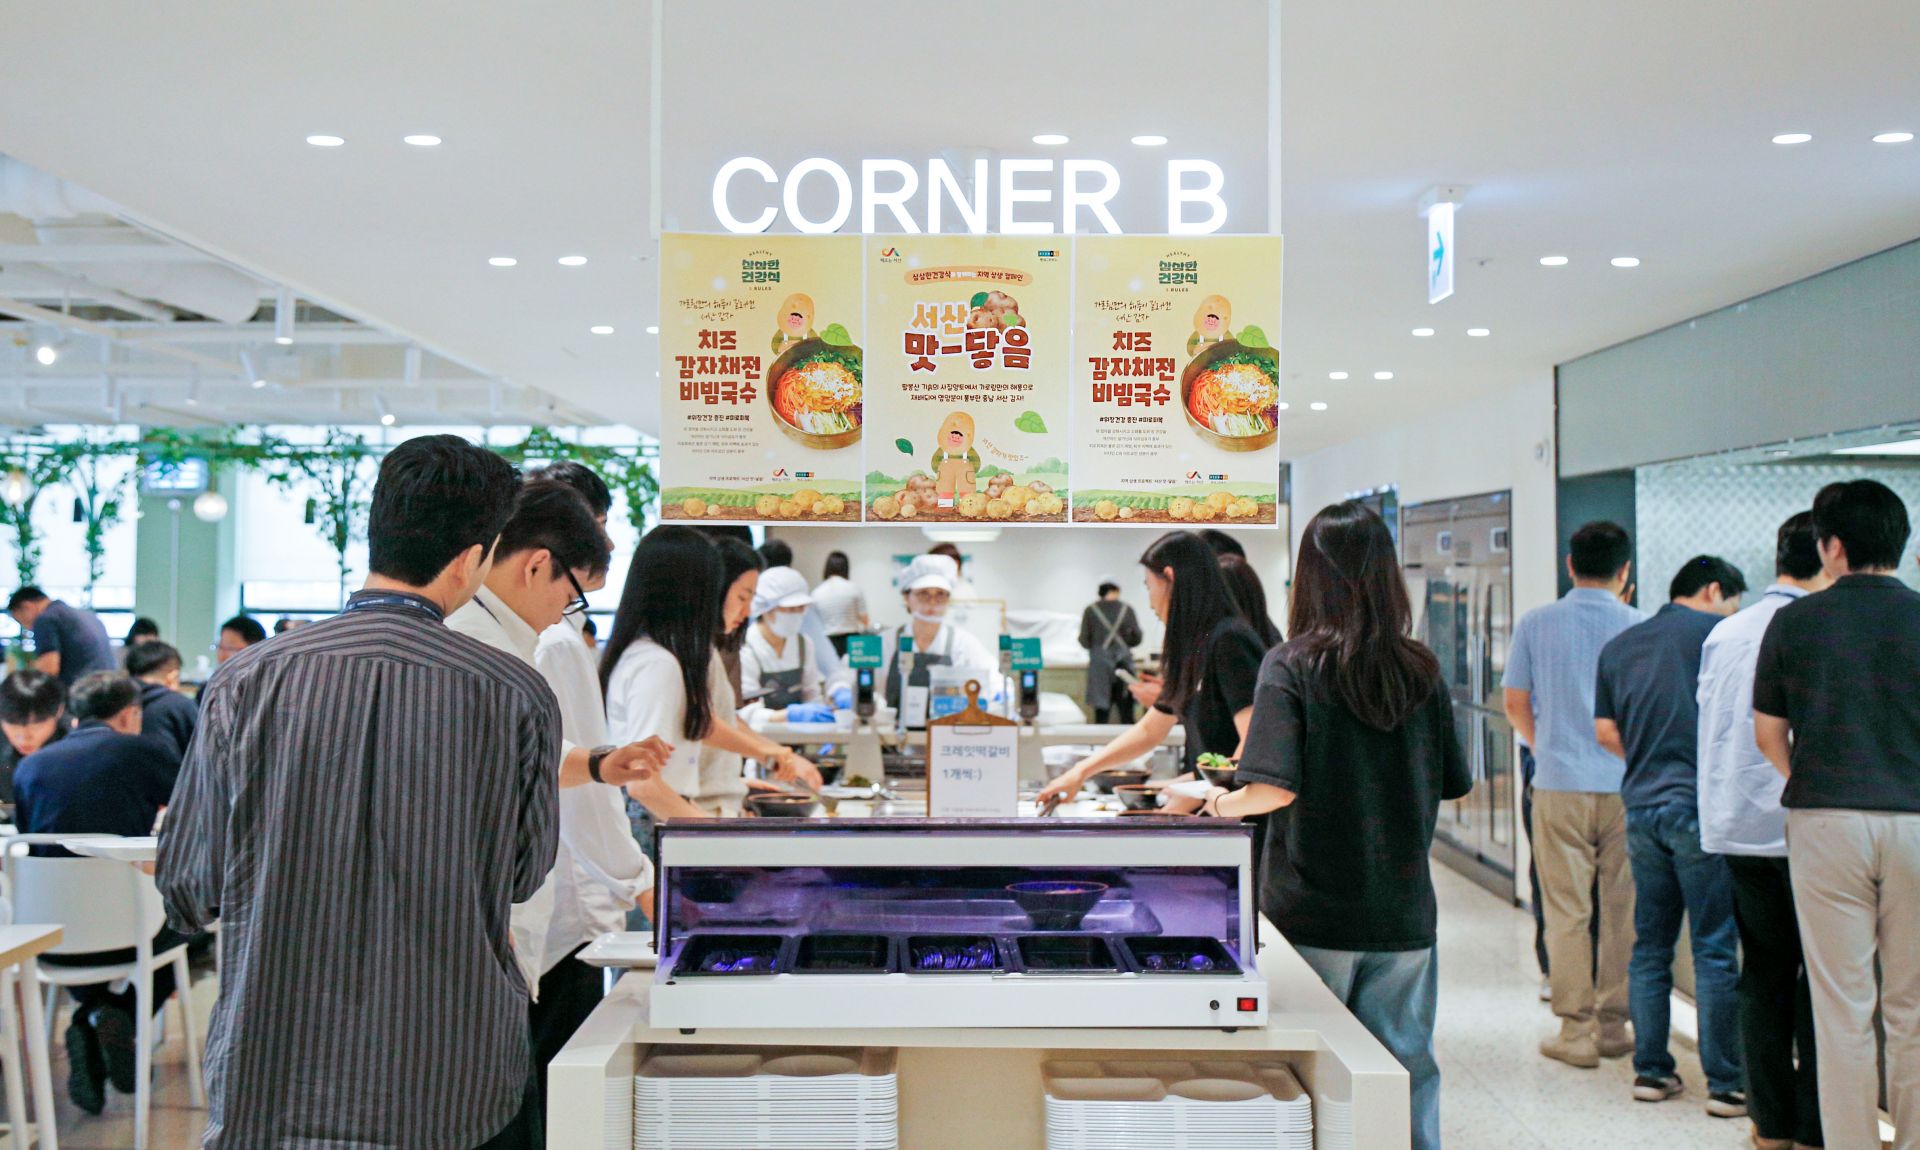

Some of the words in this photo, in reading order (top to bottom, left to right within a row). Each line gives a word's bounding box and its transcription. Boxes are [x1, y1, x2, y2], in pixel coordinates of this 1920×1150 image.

[712, 156, 1123, 235] CORNER
[1167, 158, 1228, 235] B
[741, 271, 781, 283] 건강식
[977, 271, 990, 279] 지역
[1158, 272, 1198, 284] 건강식
[912, 304, 968, 335] 서산
[698, 329, 737, 350] 치즈
[1112, 330, 1152, 352] 치즈
[675, 355, 760, 379] 감자채전
[1089, 357, 1175, 381] 감자채전
[680, 381, 757, 405] 비빔국수
[996, 394, 1008, 402] 서산
[1092, 383, 1171, 407] 비빔국수
